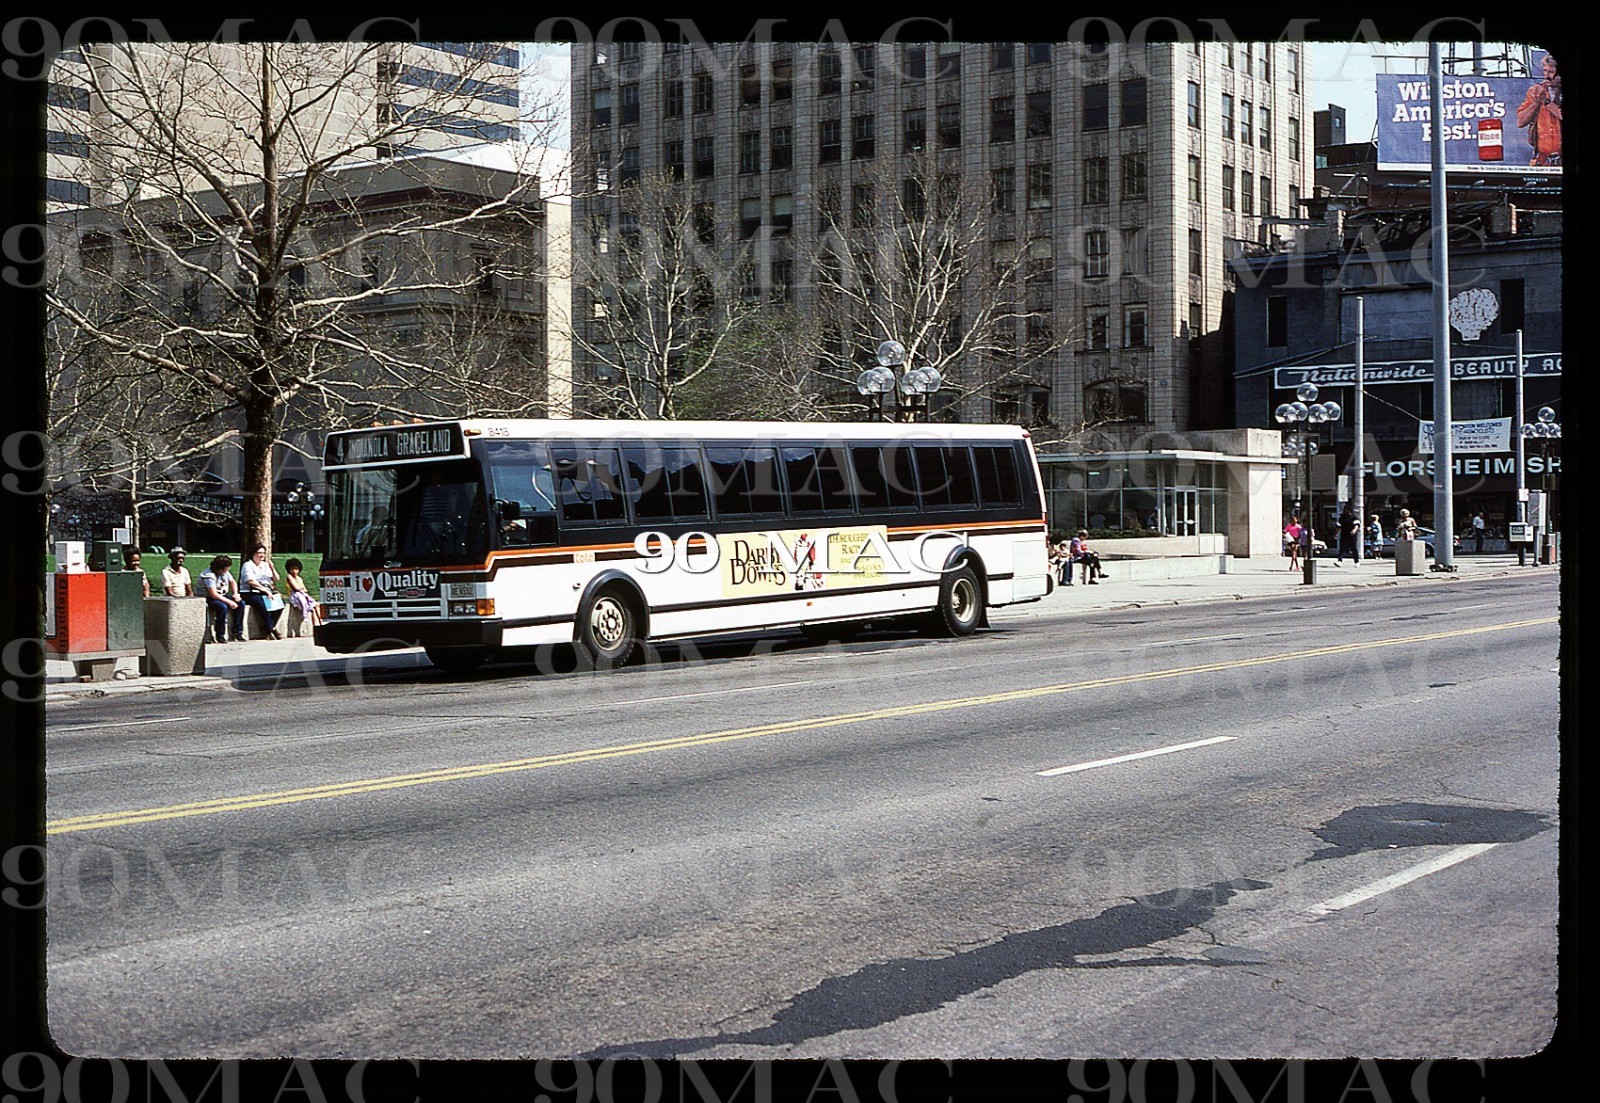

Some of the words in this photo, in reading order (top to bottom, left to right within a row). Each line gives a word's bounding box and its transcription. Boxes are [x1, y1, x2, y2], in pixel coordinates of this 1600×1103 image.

[1397, 79, 1495, 101] Wiston.
[1392, 99, 1506, 123] Amrica's
[487, 425, 510, 437] 8418
[348, 436, 388, 460] INDIANOLA
[396, 428, 451, 456] GRACELAND
[1362, 458, 1515, 477] FLORSHEIM
[376, 569, 439, 598] Quality
[325, 591, 345, 602] 8418
